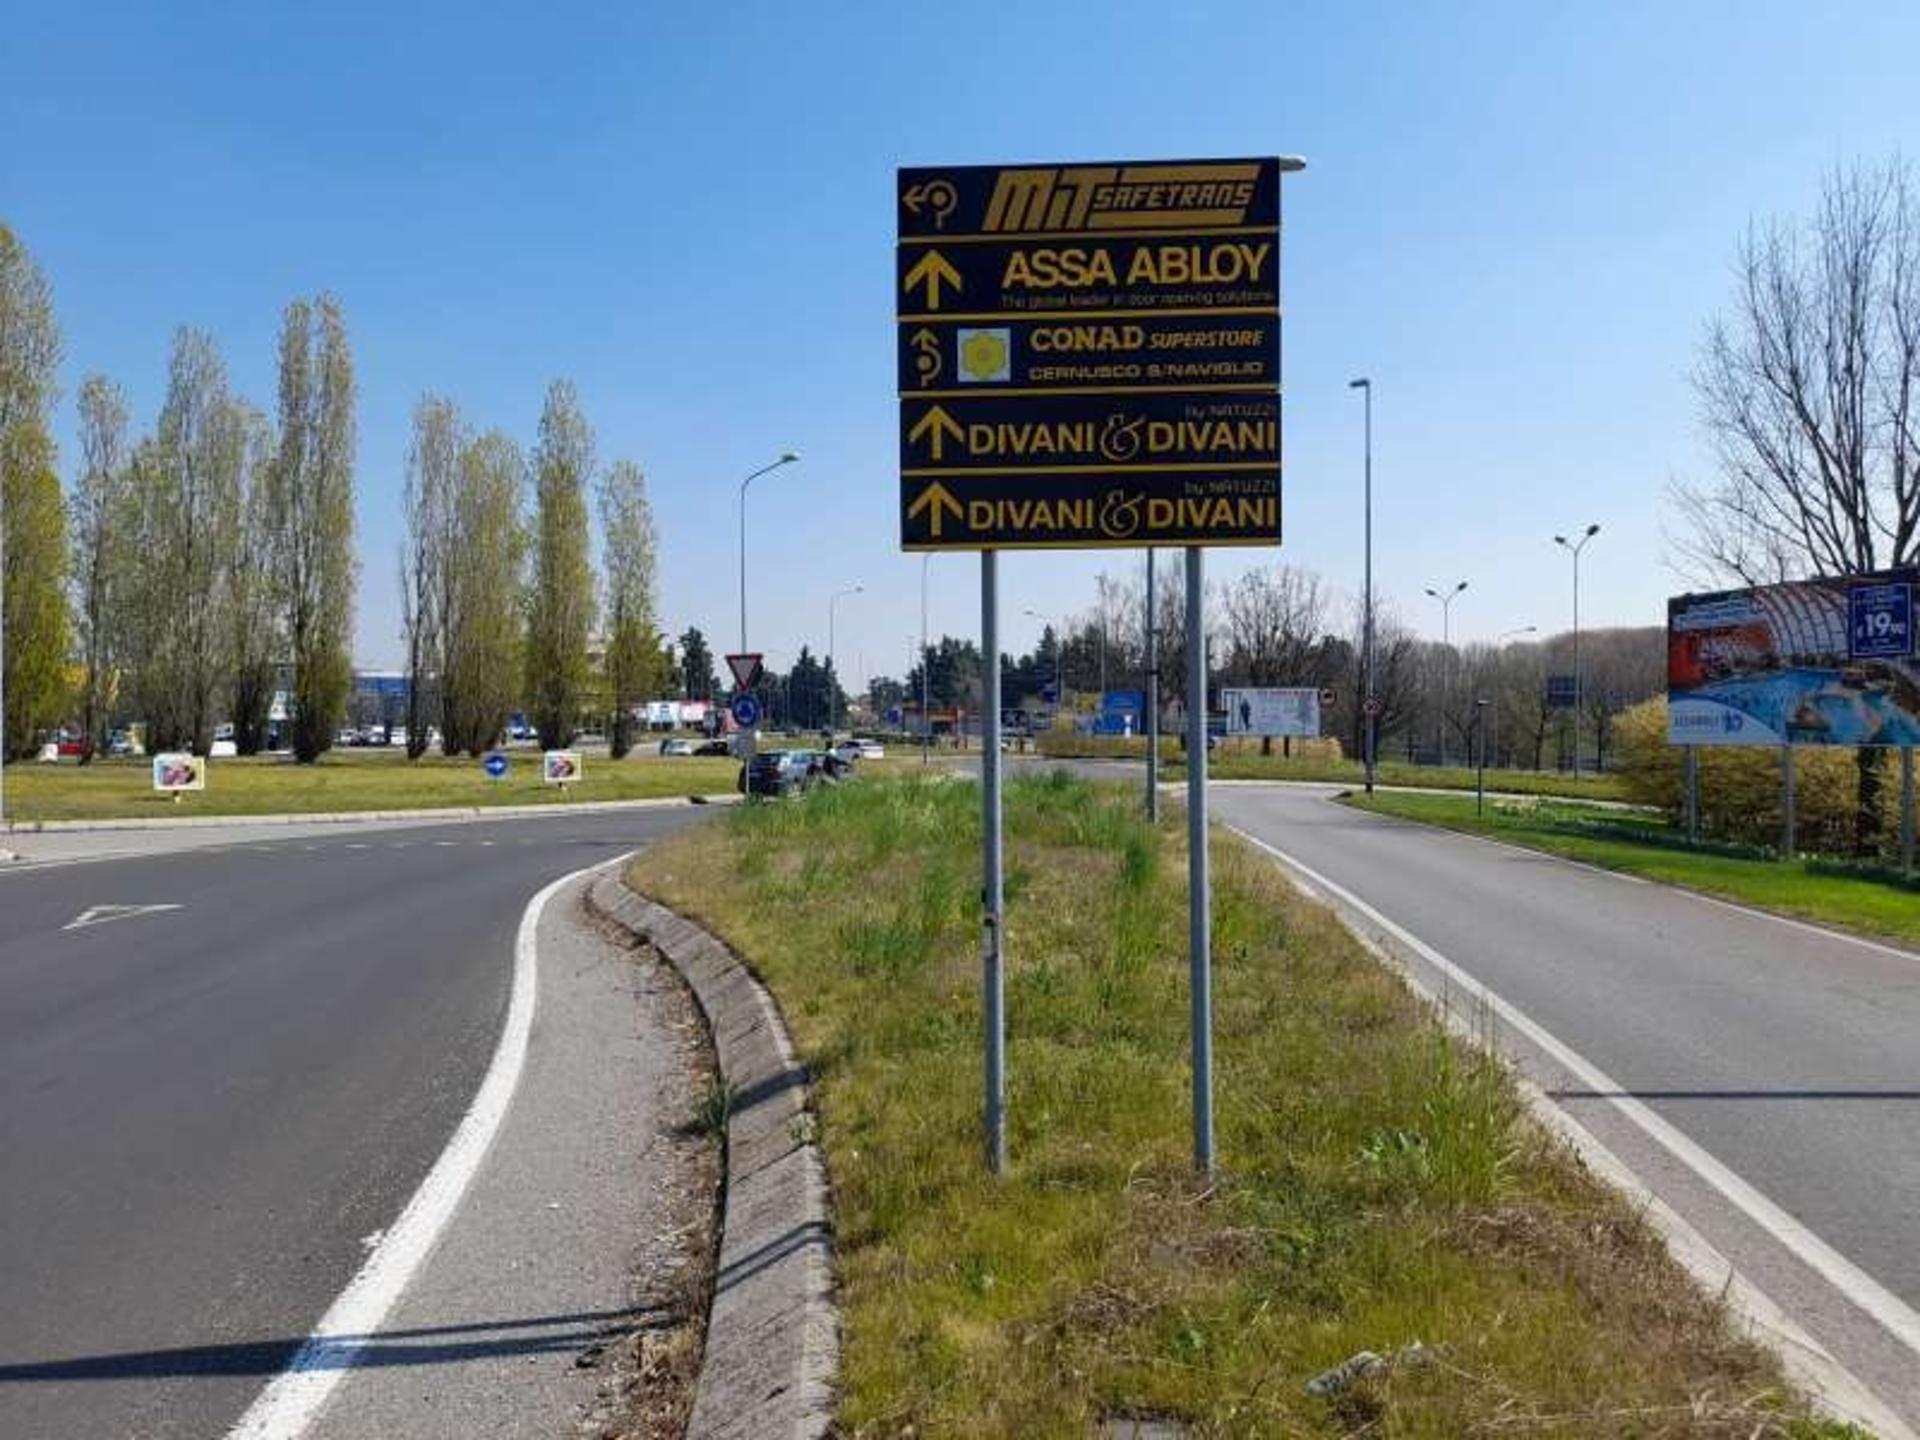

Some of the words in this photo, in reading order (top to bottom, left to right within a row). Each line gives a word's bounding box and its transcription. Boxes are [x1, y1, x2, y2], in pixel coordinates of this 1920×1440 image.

[1093, 183, 1255, 210] SAFETRANS
[1002, 248, 1118, 289] ASSA
[1126, 243, 1272, 285] ABLOY
[1030, 326, 1144, 351] CONAD
[1150, 330, 1265, 349] SUPERSTORE
[1028, 364, 1142, 381] CERNUSCO
[969, 421, 1094, 455] DIVANI
[1100, 413, 1147, 461] &
[1149, 420, 1275, 452] DIVANI
[968, 498, 1094, 531] DIVANI
[1100, 489, 1146, 538] &
[1149, 497, 1275, 530] DIVANI
